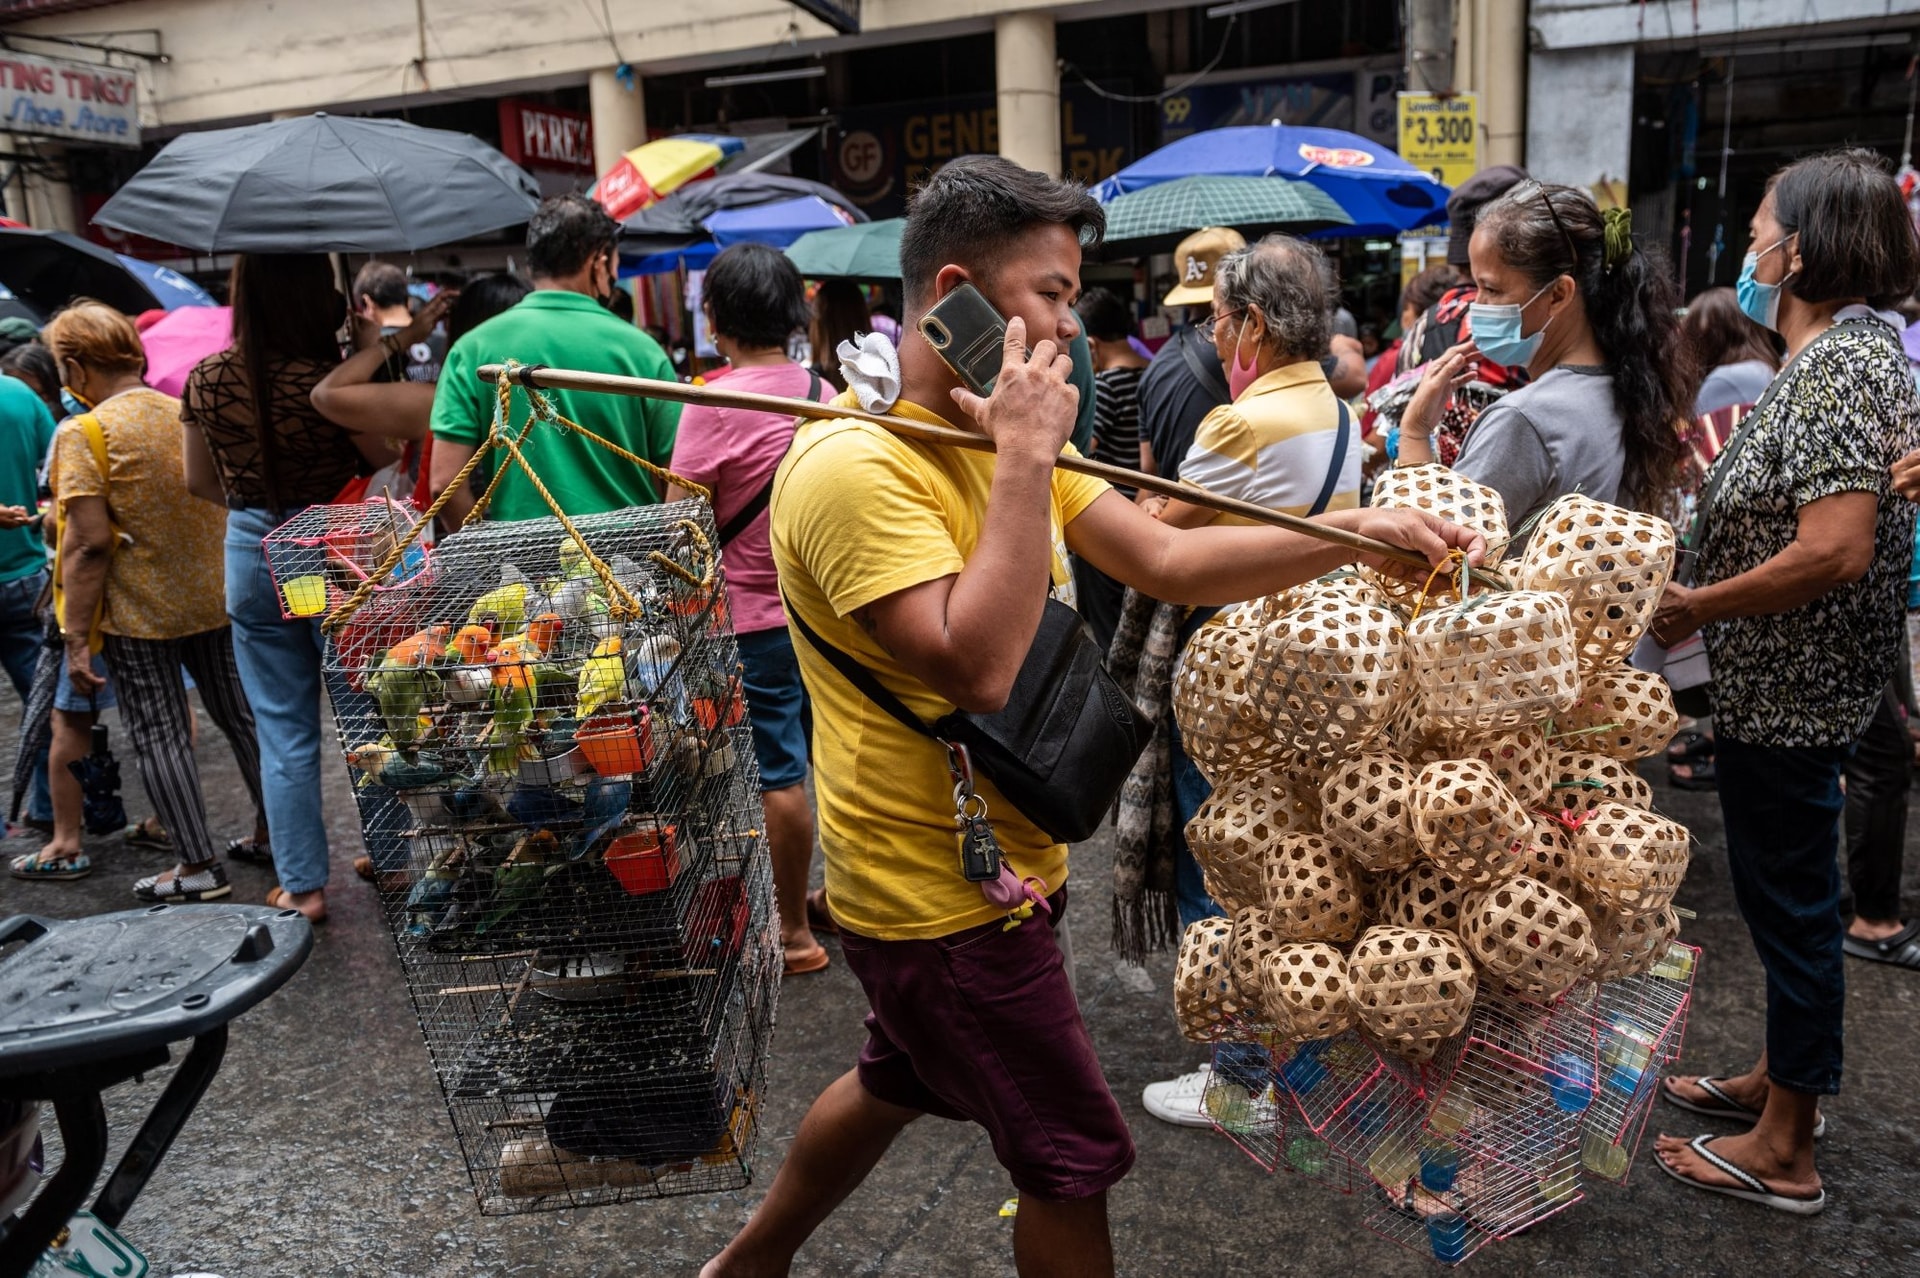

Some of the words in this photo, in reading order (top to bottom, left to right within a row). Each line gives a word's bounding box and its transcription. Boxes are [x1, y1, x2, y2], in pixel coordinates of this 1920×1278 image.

[0, 61, 54, 95] TING
[4, 96, 64, 128] Shoe
[69, 105, 128, 136] Store
[1164, 97, 1192, 124] 99
[845, 142, 878, 172] GF
